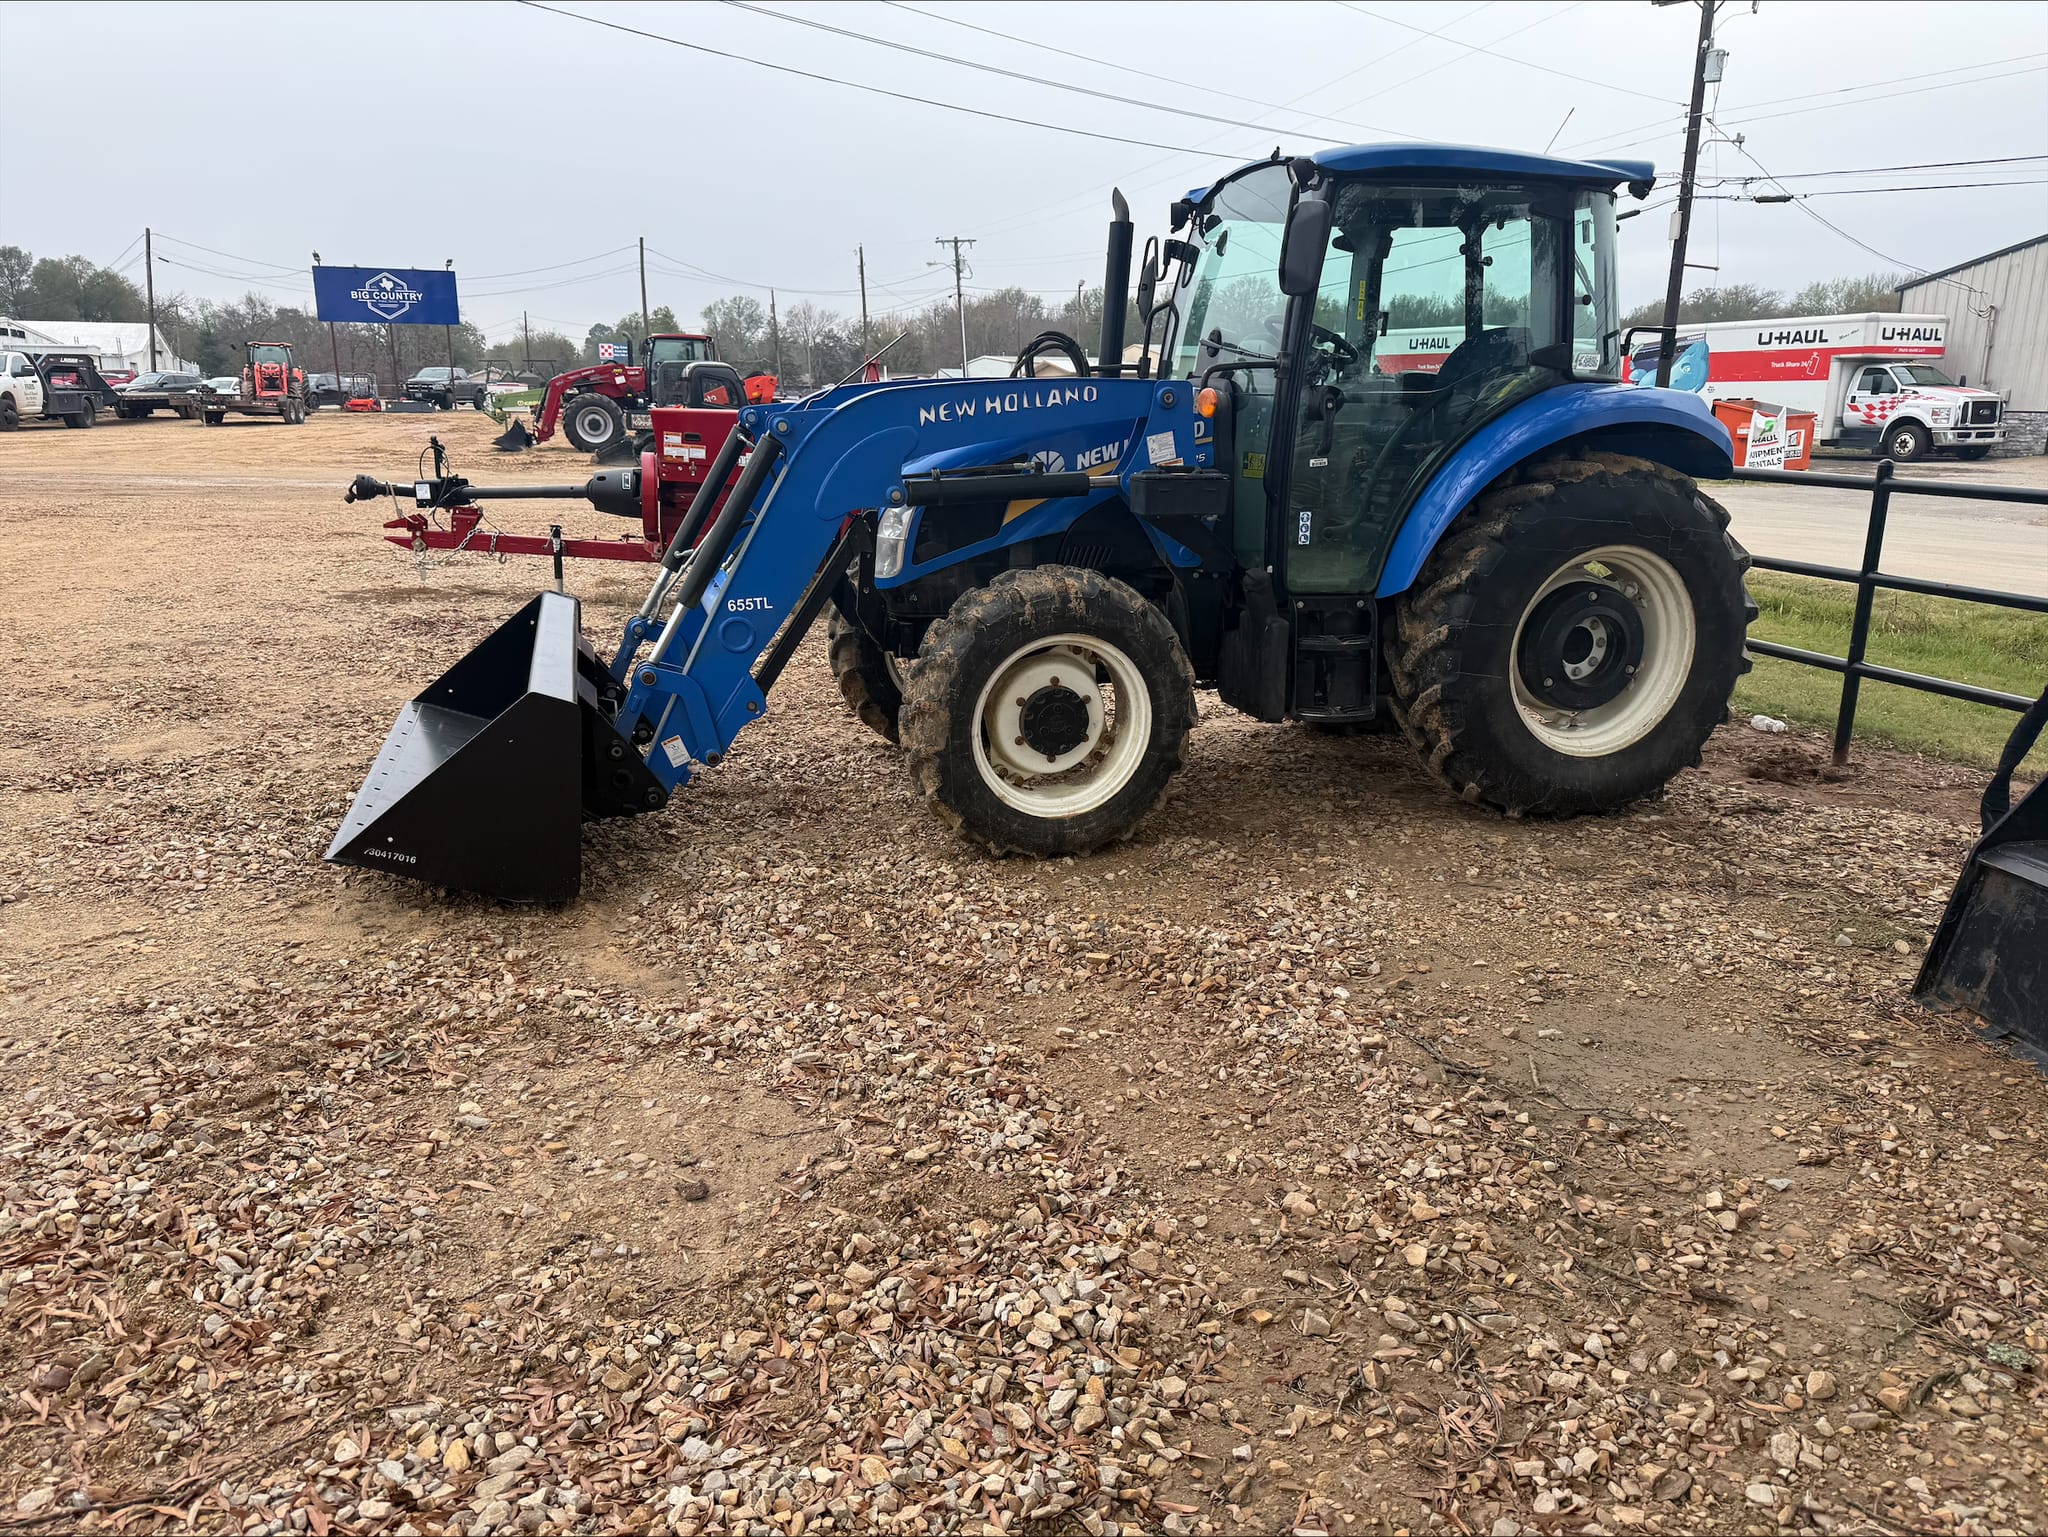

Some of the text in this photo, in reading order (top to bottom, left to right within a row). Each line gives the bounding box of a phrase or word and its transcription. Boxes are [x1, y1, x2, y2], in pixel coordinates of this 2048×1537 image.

[351, 291, 423, 301] BIG COUNTRY
[1757, 329, 1829, 346] U-HAUL
[1882, 327, 1942, 342] U-HAUL
[1409, 337, 1450, 350] U-HAUL
[919, 385, 1098, 427] NEW HOLLAND
[1076, 441, 1120, 471] NEW
[727, 597, 773, 612] 655TL
